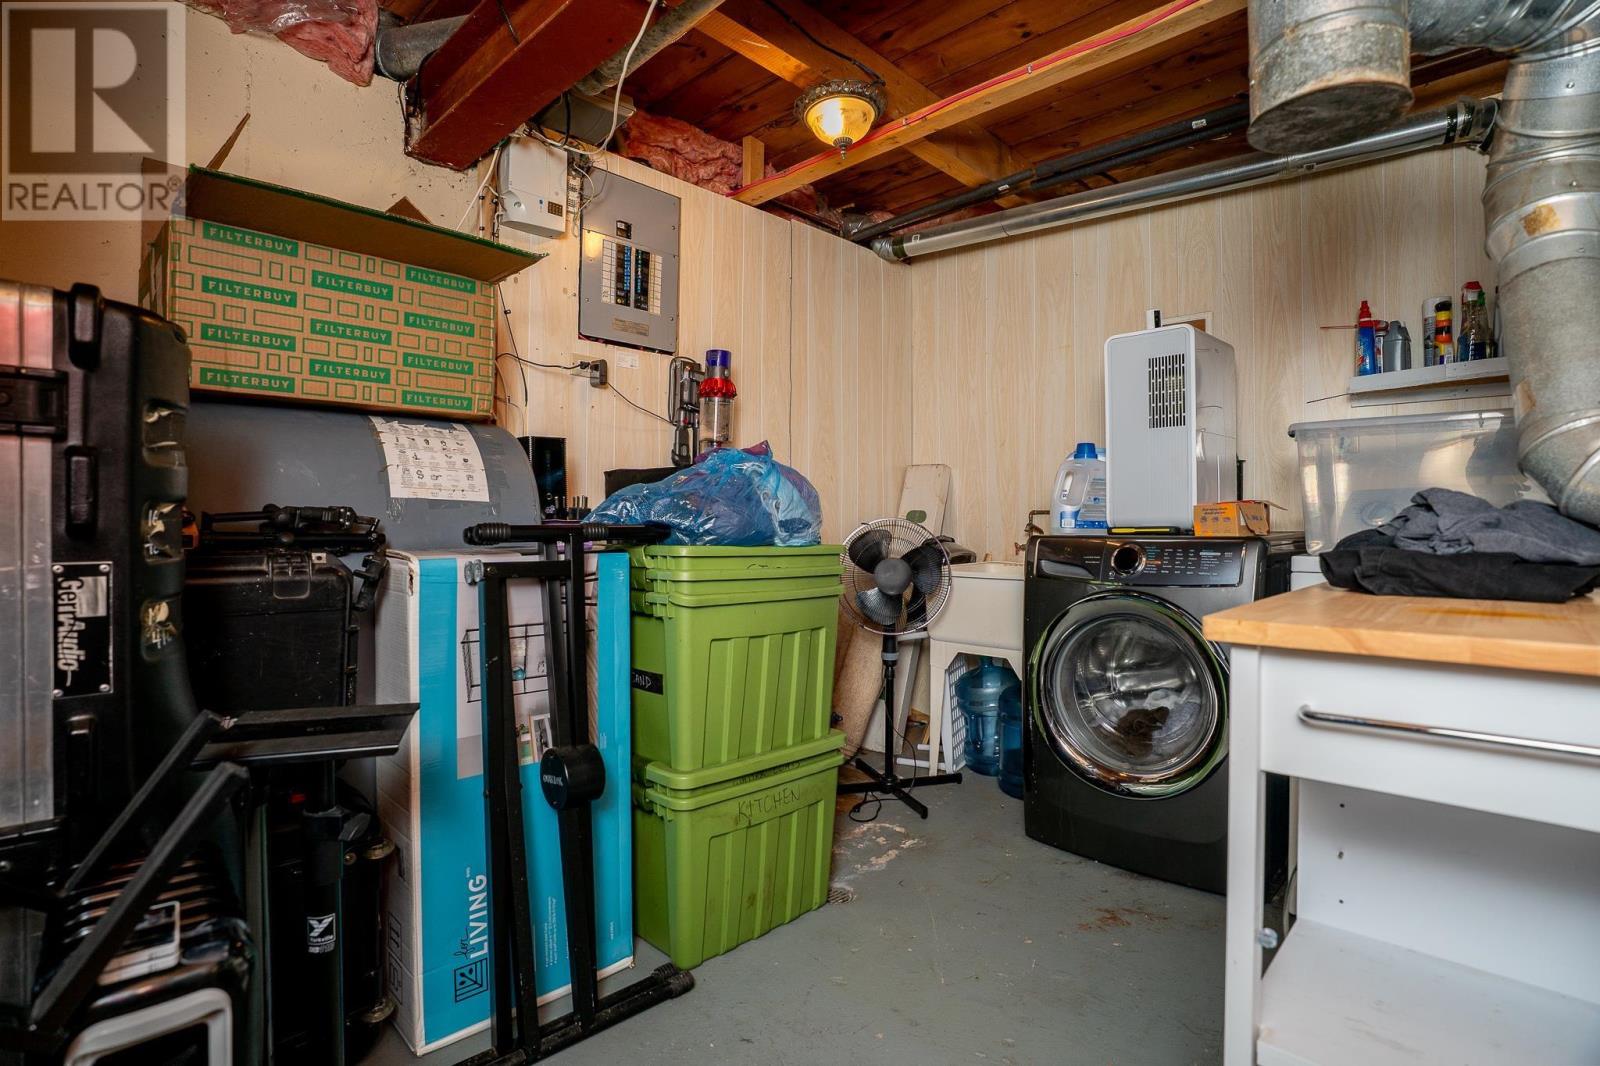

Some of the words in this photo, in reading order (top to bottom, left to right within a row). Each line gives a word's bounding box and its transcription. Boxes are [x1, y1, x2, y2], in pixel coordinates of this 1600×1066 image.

[209, 227, 294, 252] FILTERBUY
[317, 275, 389, 296] FILTERBUY
[410, 270, 473, 290] FILTERBUY
[208, 280, 292, 303] FILTERBUY
[315, 322, 387, 341] FILTERBUY
[408, 315, 471, 334] FILTERBUY
[207, 328, 291, 348] FILTERBUY
[314, 363, 386, 380] FILTERBUY
[407, 356, 470, 371] FILTERBUY
[206, 371, 290, 389] FILTERBUY
[406, 393, 469, 408] FILTERBUY
[737, 786, 800, 827] KITCHEN
[468, 874, 489, 959] LIVING
